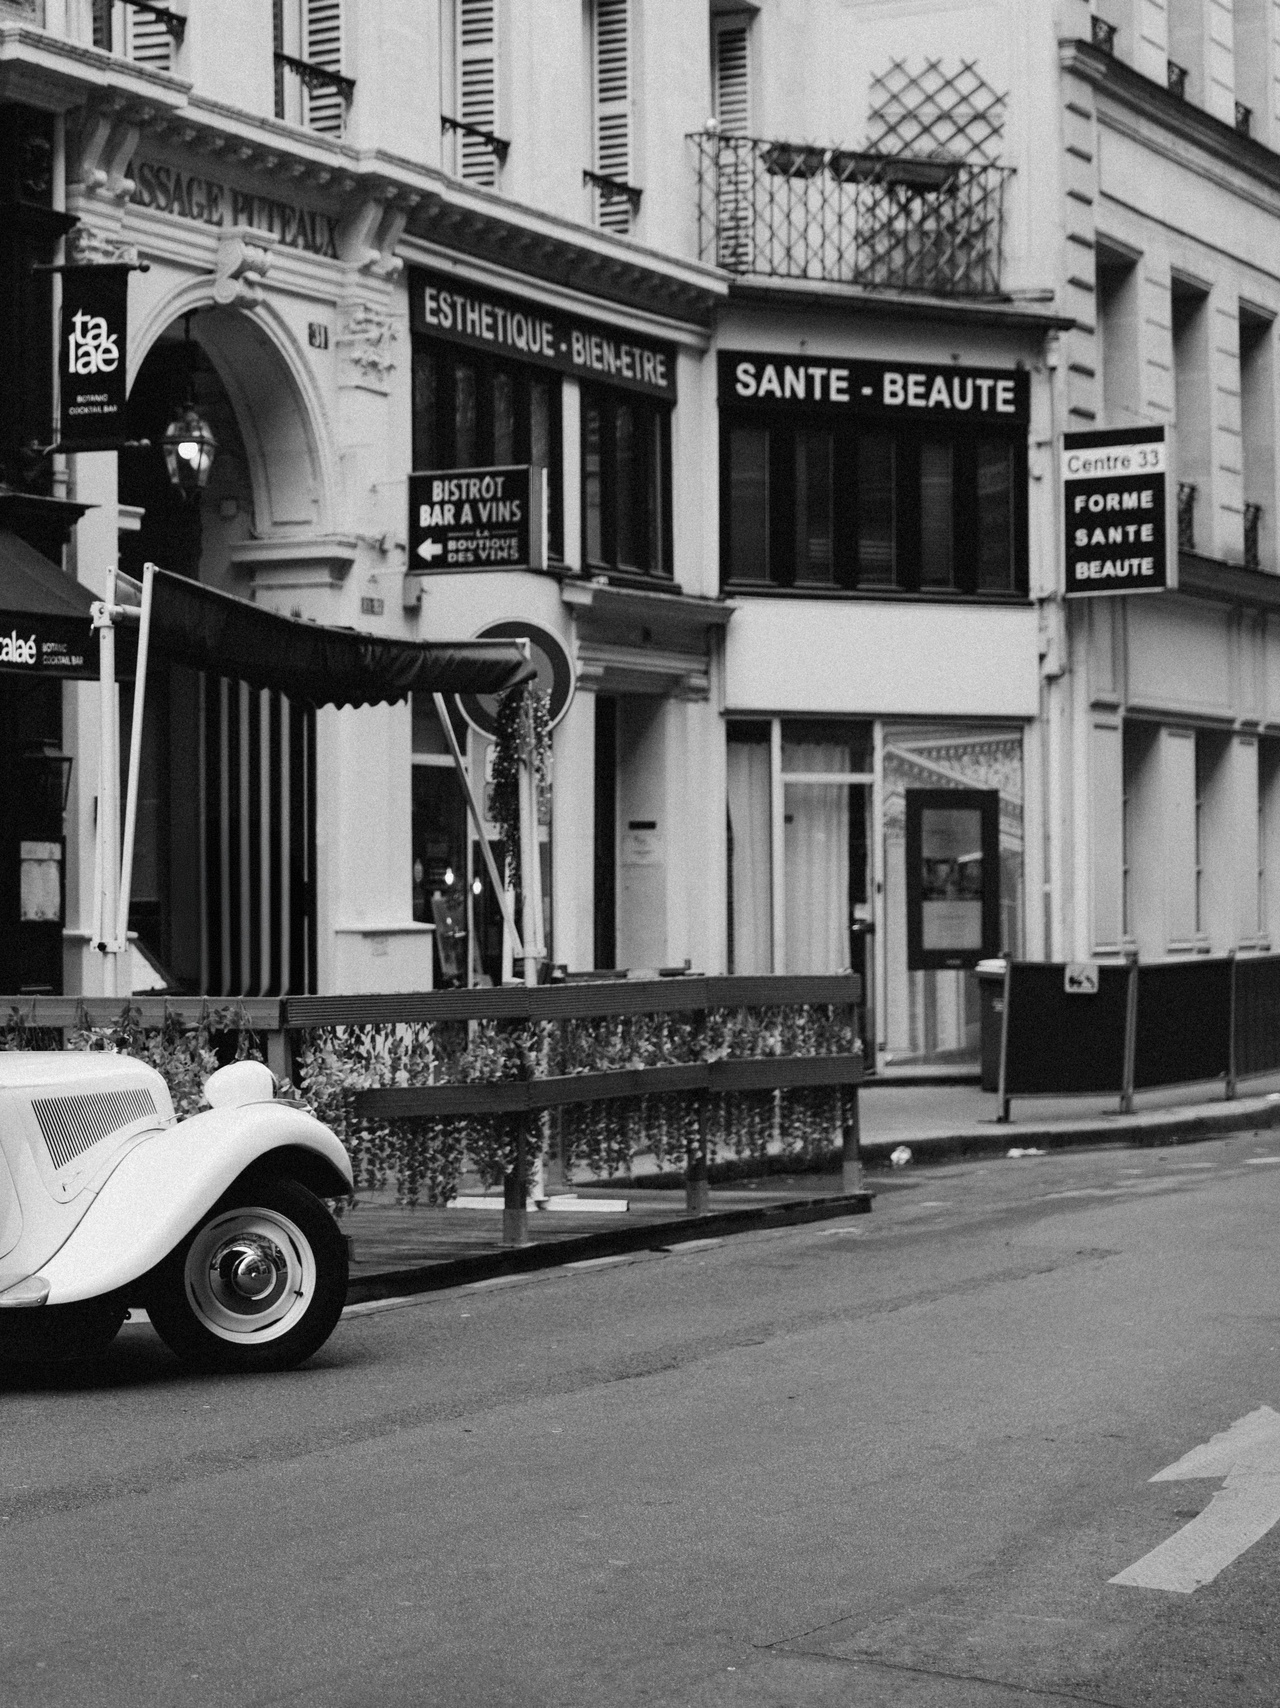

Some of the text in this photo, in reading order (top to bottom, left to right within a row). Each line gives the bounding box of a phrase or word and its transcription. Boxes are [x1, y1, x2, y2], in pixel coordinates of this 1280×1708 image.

[123, 160, 224, 228] ASSAGE
[425, 286, 555, 357] ESTHETIQUE
[572, 330, 668, 387] BIEN-ETRE
[735, 362, 850, 402] SANTE
[883, 372, 1016, 413] BEAUTE
[1067, 449, 1159, 473] Centre 33
[1074, 489, 1154, 514] FORME
[419, 500, 521, 528] BAR A VINS
[447, 537, 518, 551] BOUTIQUE
[476, 529, 490, 538] LA
[1074, 523, 1154, 547] SANTE
[447, 547, 519, 562] DES VINS
[1075, 557, 1155, 580] BEAUTE
